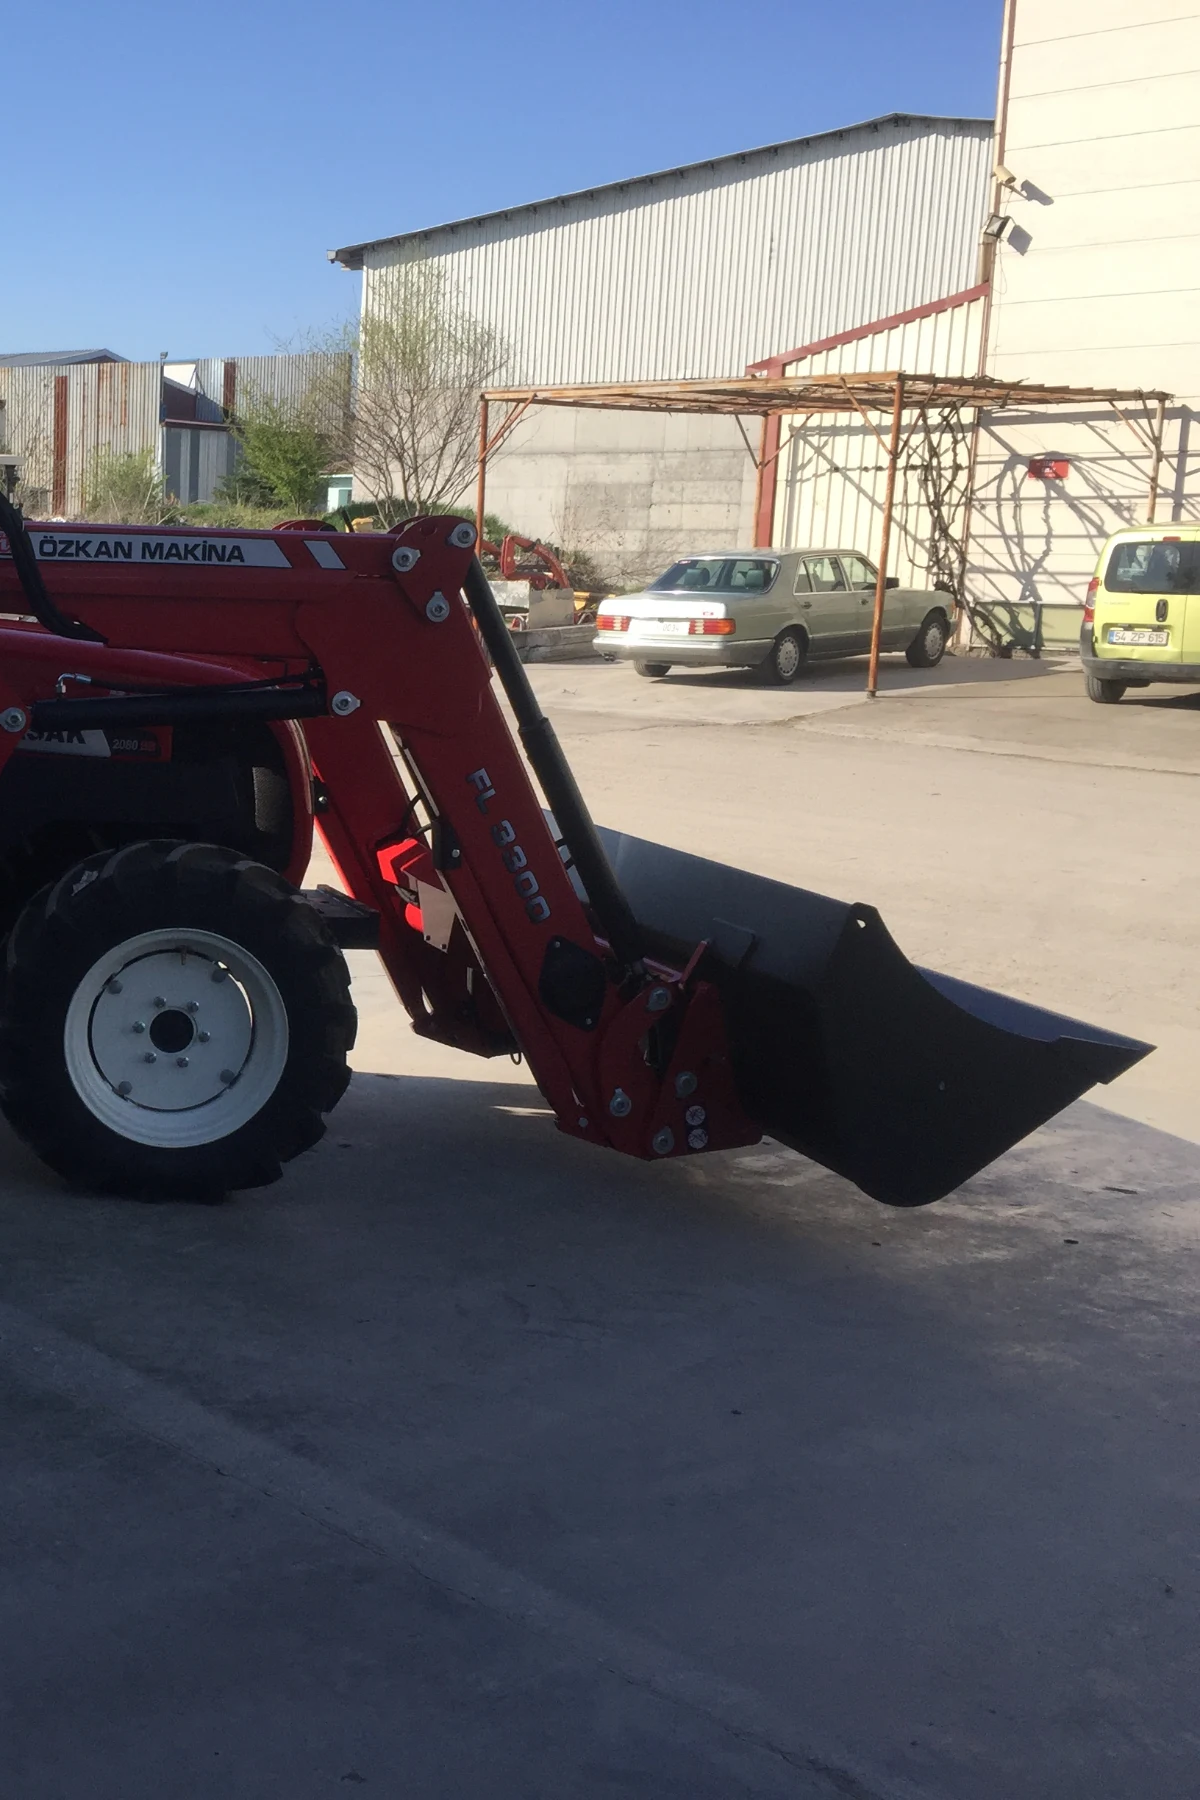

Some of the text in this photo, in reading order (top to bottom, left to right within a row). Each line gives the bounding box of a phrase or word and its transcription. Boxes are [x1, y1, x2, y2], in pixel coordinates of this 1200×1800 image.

[38, 535, 246, 563] ÖZKAN MAKİNA
[1115, 631, 1165, 643] 54 ZP 615
[112, 739, 139, 750] 2080
[465, 767, 551, 924] FL 3300
